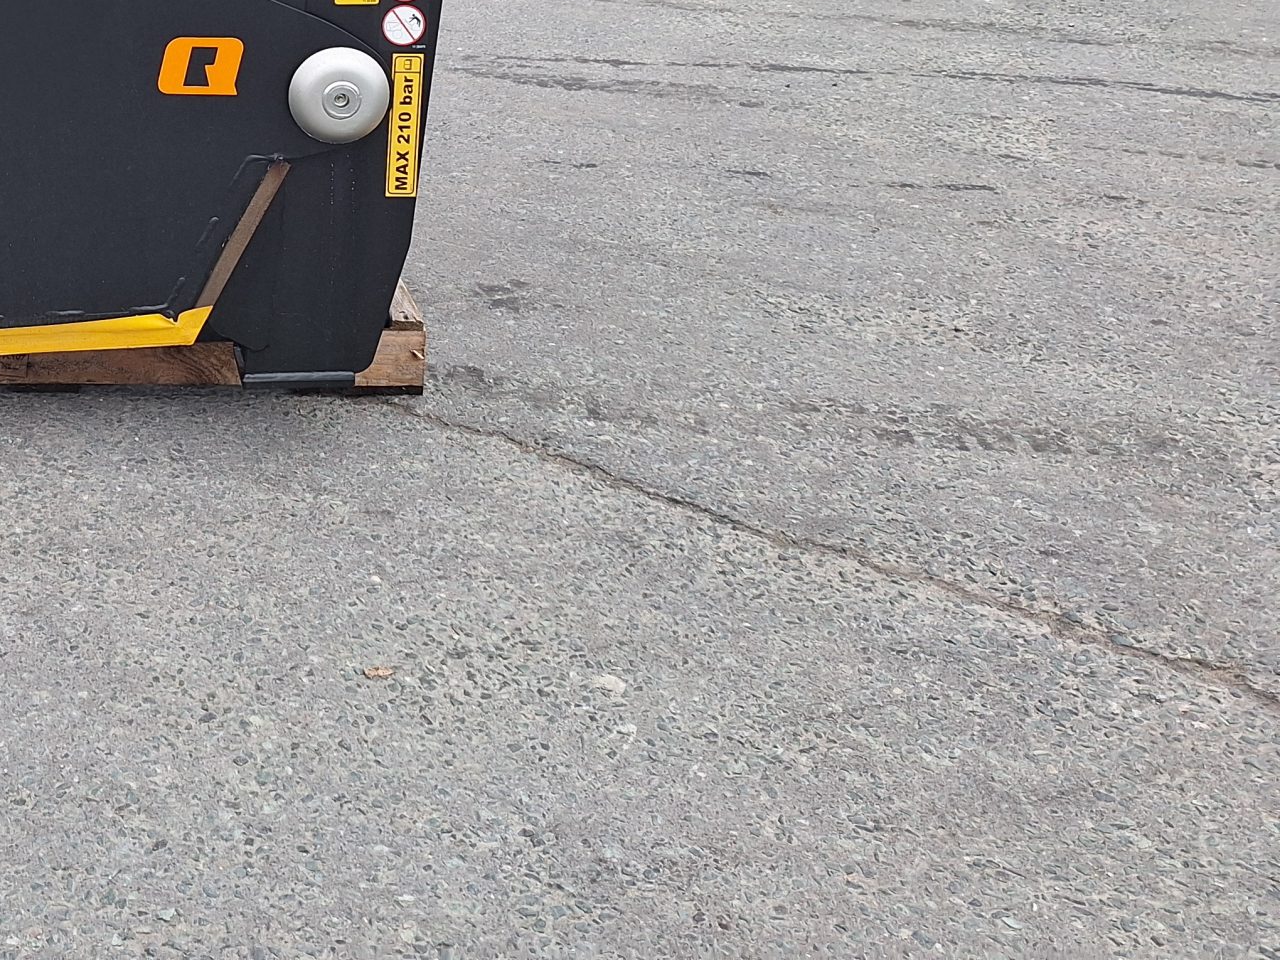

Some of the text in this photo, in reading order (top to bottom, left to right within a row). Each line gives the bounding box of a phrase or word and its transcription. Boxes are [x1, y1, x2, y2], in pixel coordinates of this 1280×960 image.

[395, 76, 414, 191] MAX 210 bar
